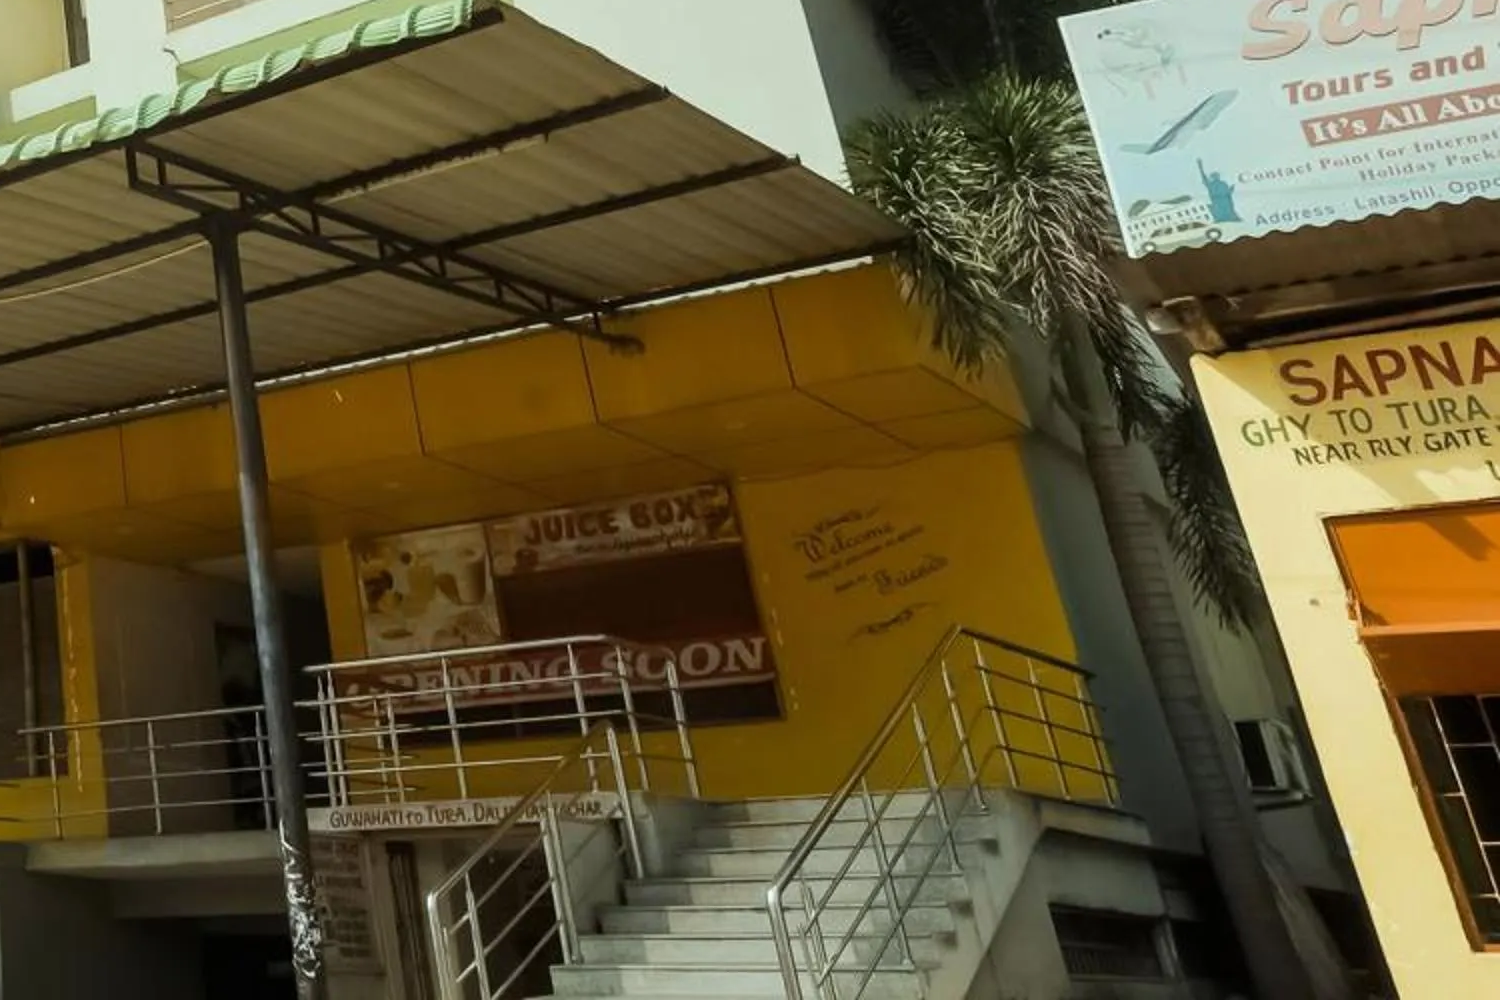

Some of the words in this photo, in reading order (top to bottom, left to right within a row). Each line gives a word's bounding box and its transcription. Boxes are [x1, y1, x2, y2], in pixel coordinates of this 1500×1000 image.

[1282, 68, 1393, 105] Tours
[1410, 46, 1485, 81] and
[1308, 118, 1368, 143] It's
[1377, 103, 1428, 131] All
[1238, 162, 1312, 184] Contact
[1319, 152, 1372, 171] Point
[1378, 143, 1405, 161] for
[1359, 161, 1437, 182] Holiday
[1445, 148, 1500, 167] Pack
[1255, 204, 1335, 226] Address
[1279, 335, 1500, 407] SAPNA
[1241, 413, 1312, 447] GHY
[1328, 407, 1373, 436] TO
[1386, 394, 1491, 430] TURA
[1292, 441, 1363, 466] NEAR
[1423, 427, 1492, 452] GATE
[525, 509, 620, 545] JUICE
[629, 494, 699, 529] BOX
[600, 637, 768, 683] SOON
